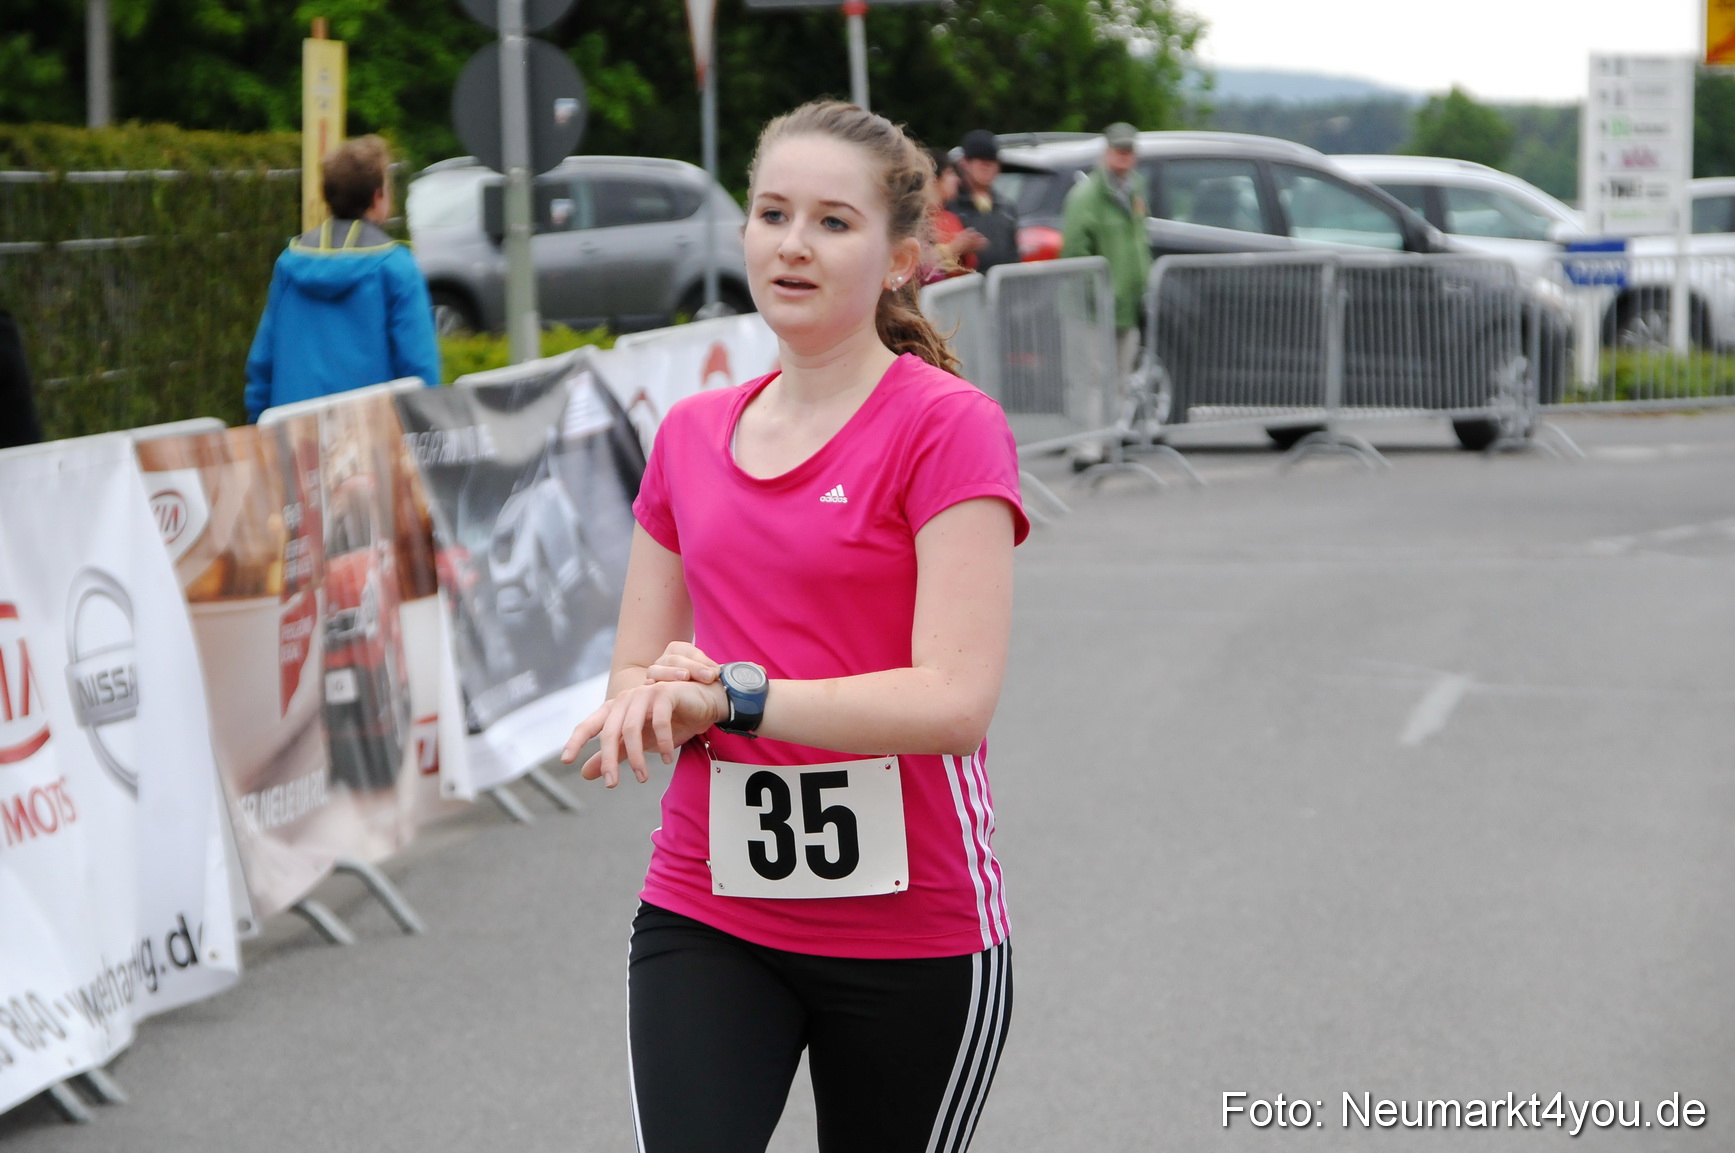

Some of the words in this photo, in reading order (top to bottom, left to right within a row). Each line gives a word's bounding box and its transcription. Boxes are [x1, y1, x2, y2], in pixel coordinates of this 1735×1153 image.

[819, 495, 848, 504] adidas
[73, 662, 140, 710] NISSA
[745, 770, 860, 881] 35
